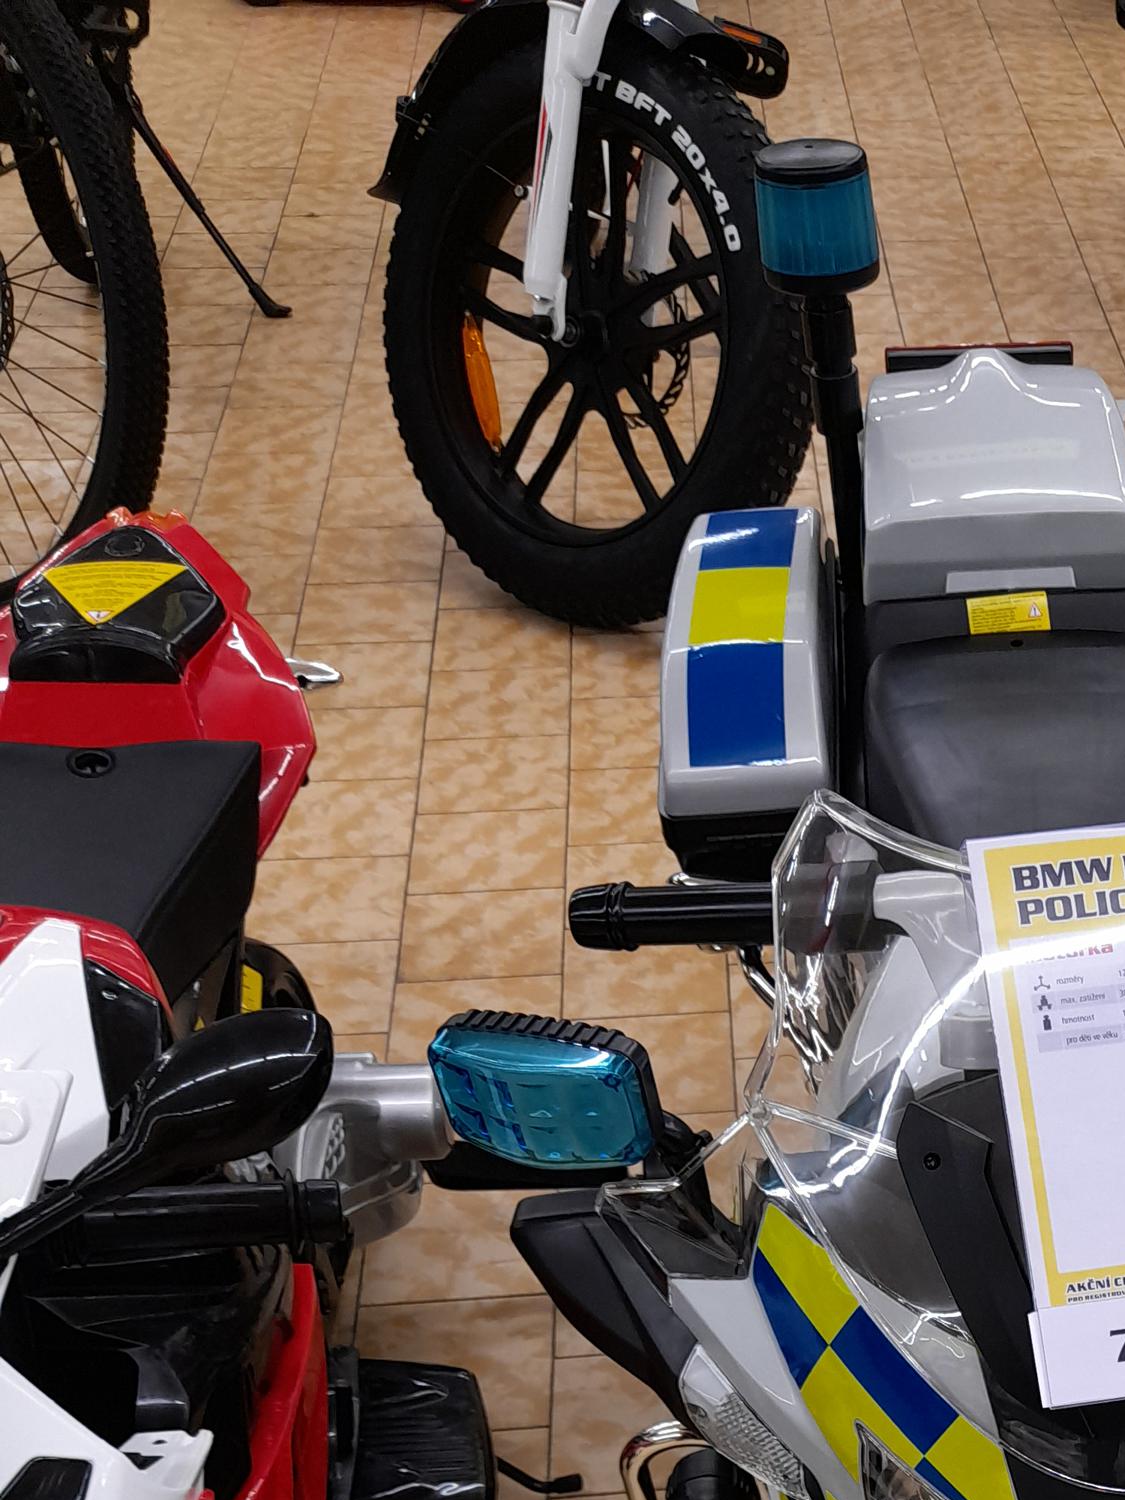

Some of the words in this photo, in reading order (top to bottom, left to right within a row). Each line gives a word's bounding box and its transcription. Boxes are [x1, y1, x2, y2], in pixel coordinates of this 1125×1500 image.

[615, 80, 672, 126] BFT
[1012, 856, 1112, 892] BMW
[1066, 1037, 1078, 1046] pro
[1066, 1276, 1111, 1294] AKČNÍ
[1067, 1295, 1084, 1303] PRO
